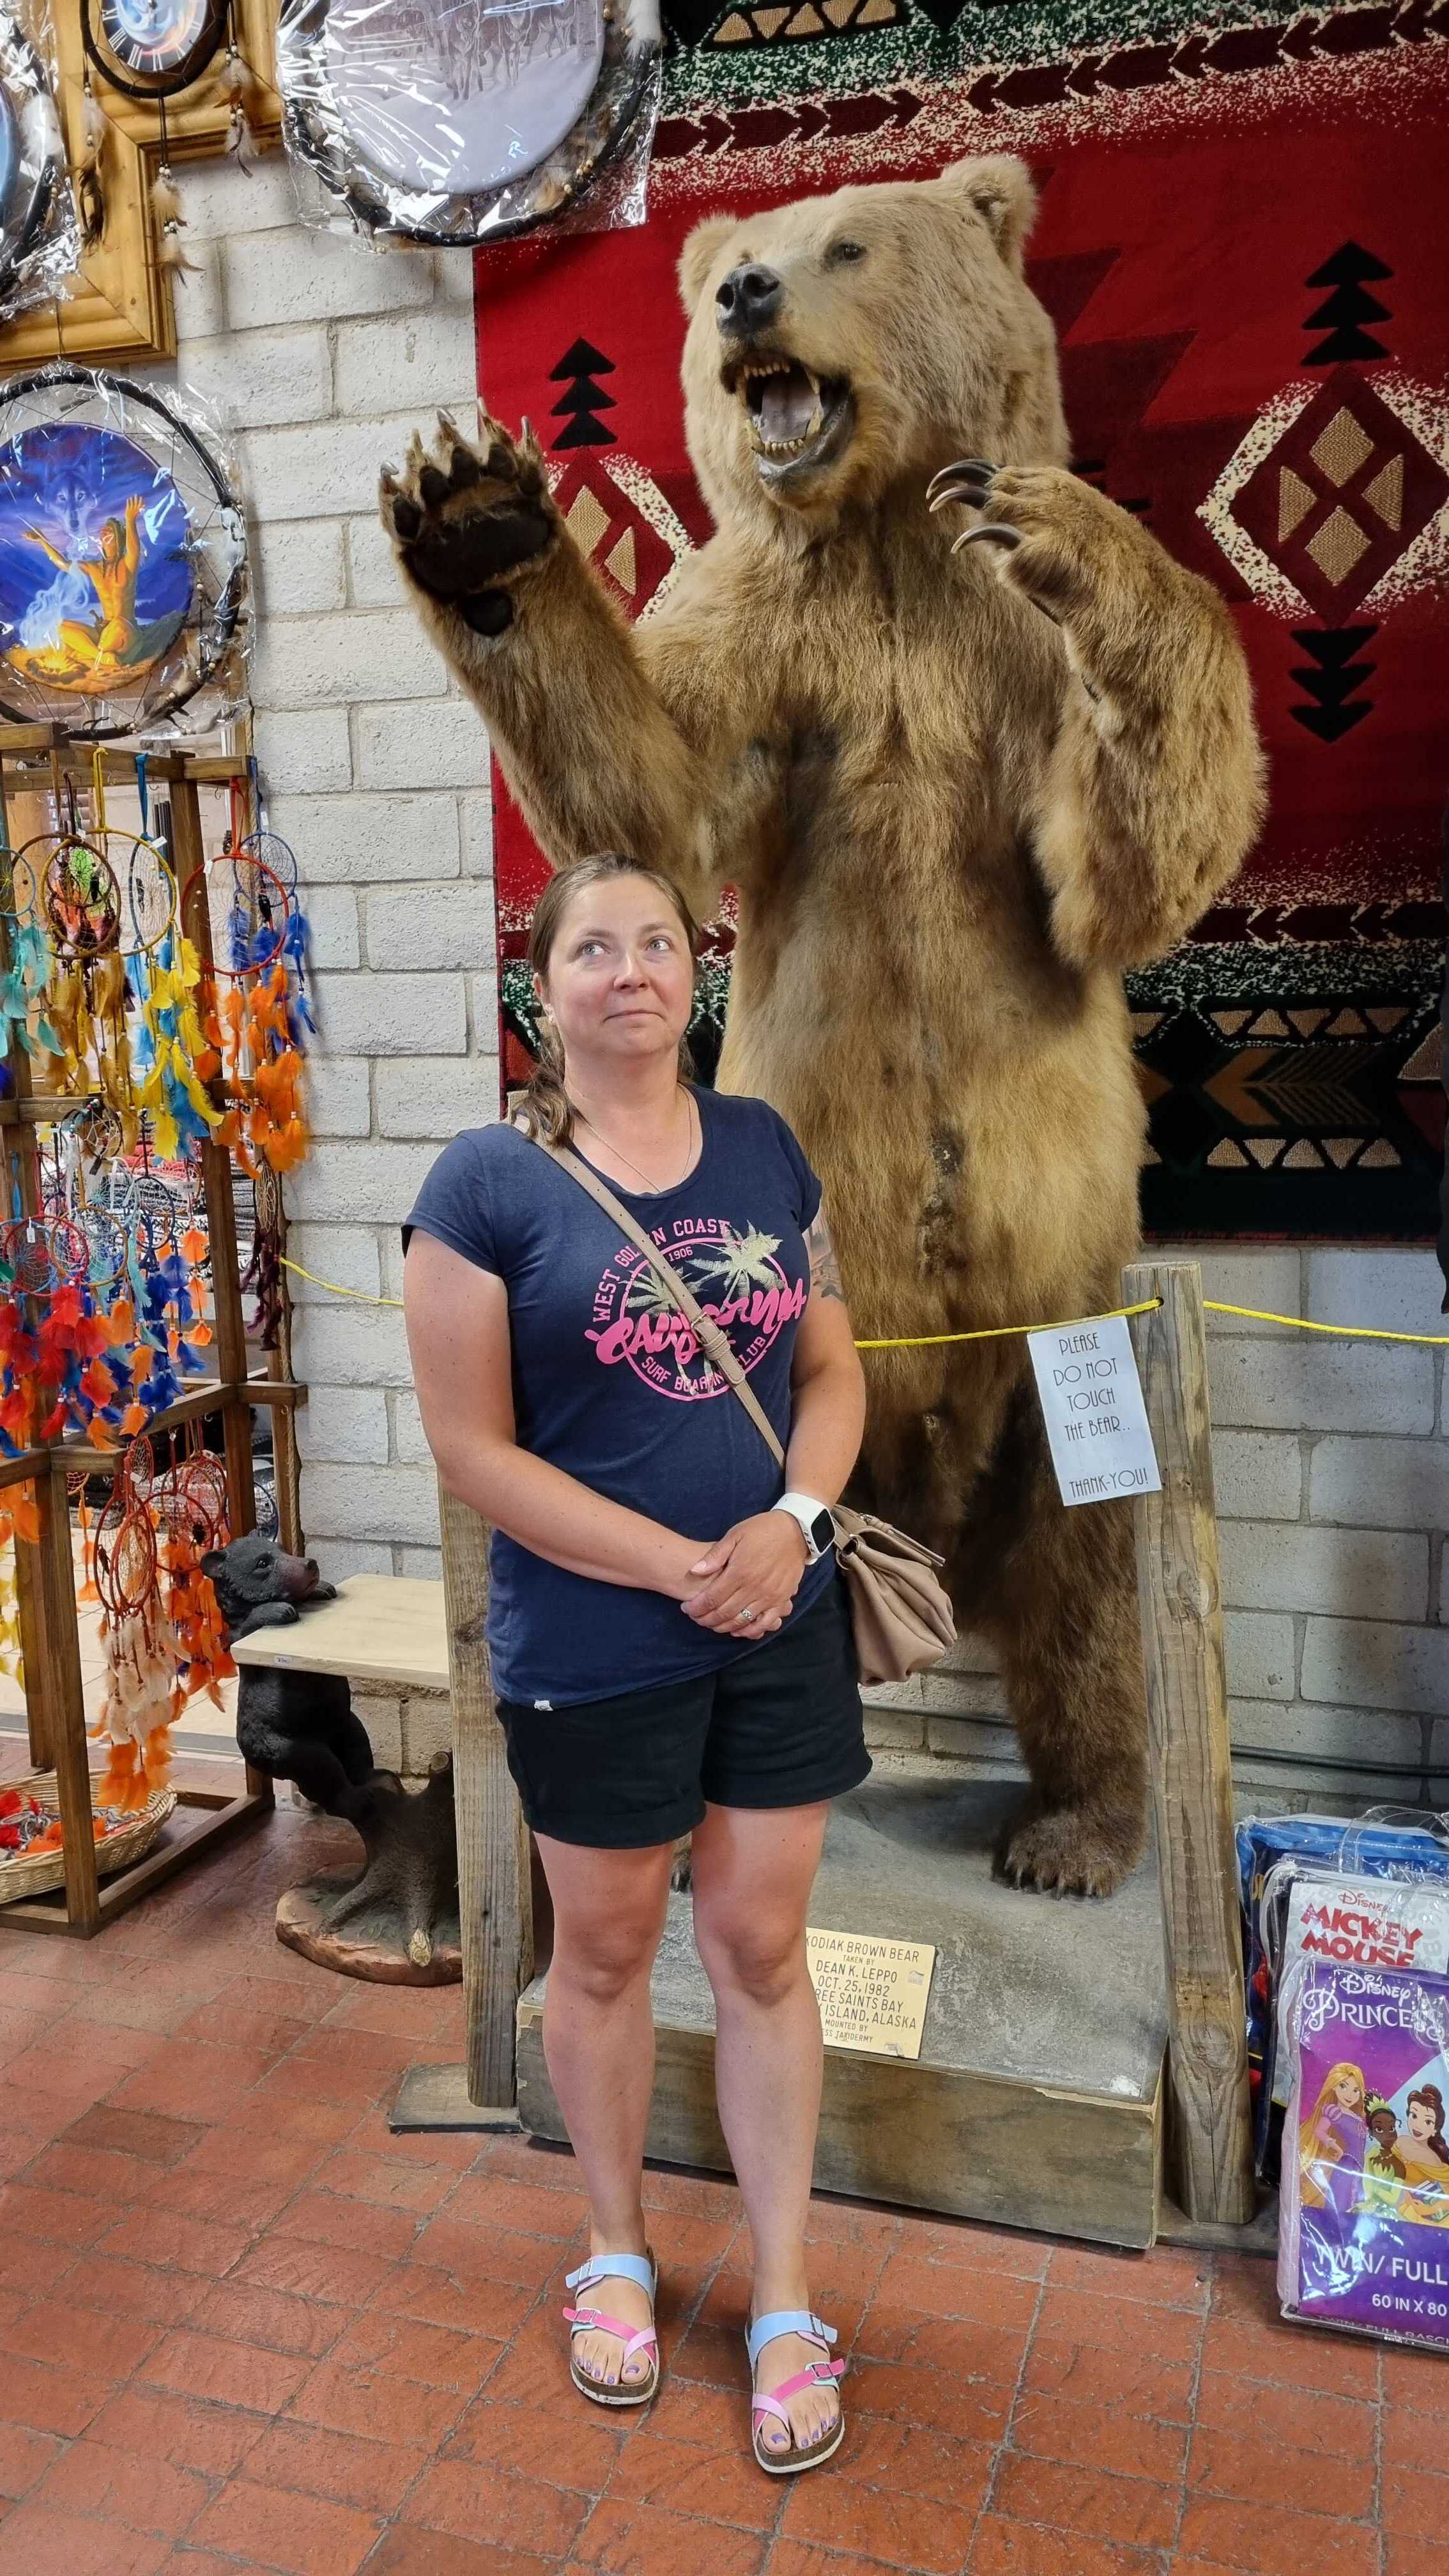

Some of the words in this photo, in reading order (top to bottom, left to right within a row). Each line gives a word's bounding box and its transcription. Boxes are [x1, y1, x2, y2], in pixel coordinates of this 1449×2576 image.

[668, 1246, 693, 1262] 1906
[593, 1269, 621, 1322] WEST
[614, 1227, 667, 1268] GOLN
[673, 1218, 732, 1238] COAST
[1058, 1332, 1101, 1355] PLEASE
[641, 1356, 671, 1383] SURF
[674, 1370, 724, 1392] BOARDIN
[736, 1337, 766, 1366] LUB
[1053, 1365, 1081, 1386] DO
[1086, 1358, 1118, 1380] NOT
[1066, 1388, 1116, 1412] TOUCH
[1064, 1422, 1085, 1441] THE
[1069, 1468, 1149, 1498] THANK-YOU!
[1300, 1902, 1424, 1951] MICKEY
[843, 1954, 864, 1964] TAKEN
[847, 1941, 887, 1959] BROWN
[890, 1947, 920, 1963] BEAR
[1300, 1929, 1415, 1966] MOUSE
[816, 1959, 847, 1975] DEAN
[848, 1965, 859, 1977] K.
[862, 1967, 898, 1983] LEPPO
[818, 1975, 841, 1990] OCT.
[864, 1982, 891, 1997] 1982
[815, 1988, 836, 2003] REE
[838, 1992, 879, 2010] SAINTS
[881, 2000, 904, 2013] BAY
[825, 2004, 870, 2023] ISLAND,
[872, 2011, 917, 2030] ALASKA
[825, 2018, 856, 2030] MOUNTED
[859, 2024, 868, 2032] BY
[834, 2030, 873, 2043] TAXIDERMY
[1317, 2245, 1385, 2274] TWN/
[1392, 2257, 1448, 2286] FULL
[1372, 2293, 1391, 2308] 60
[1395, 2297, 1410, 2312] IN
[1413, 2299, 1423, 2314] X
[1427, 2302, 1447, 2317] 80
